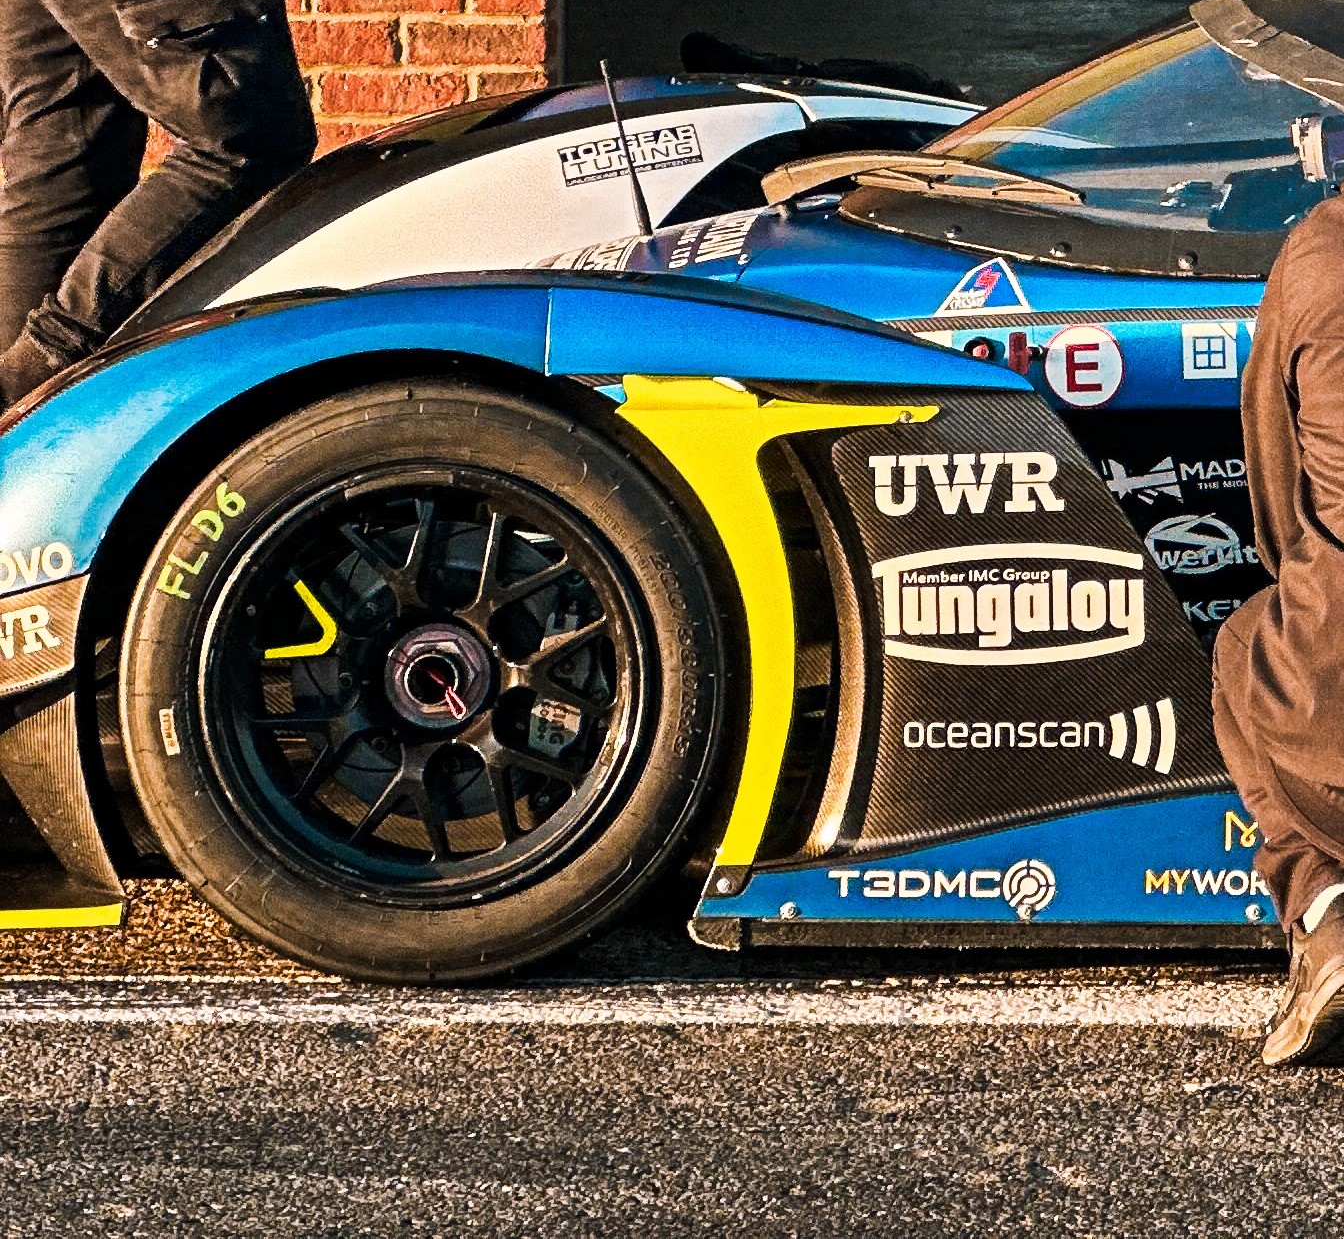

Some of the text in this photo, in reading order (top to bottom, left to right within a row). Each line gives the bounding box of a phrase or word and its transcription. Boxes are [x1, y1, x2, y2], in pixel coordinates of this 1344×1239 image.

[1065, 342, 1103, 394] E
[868, 450, 1065, 518] UWR
[902, 568, 1051, 586] Member IMC Group
[871, 564, 1146, 648] Tungaloy
[902, 719, 1104, 750] oceanscan
[828, 869, 1001, 899] T3DMC
